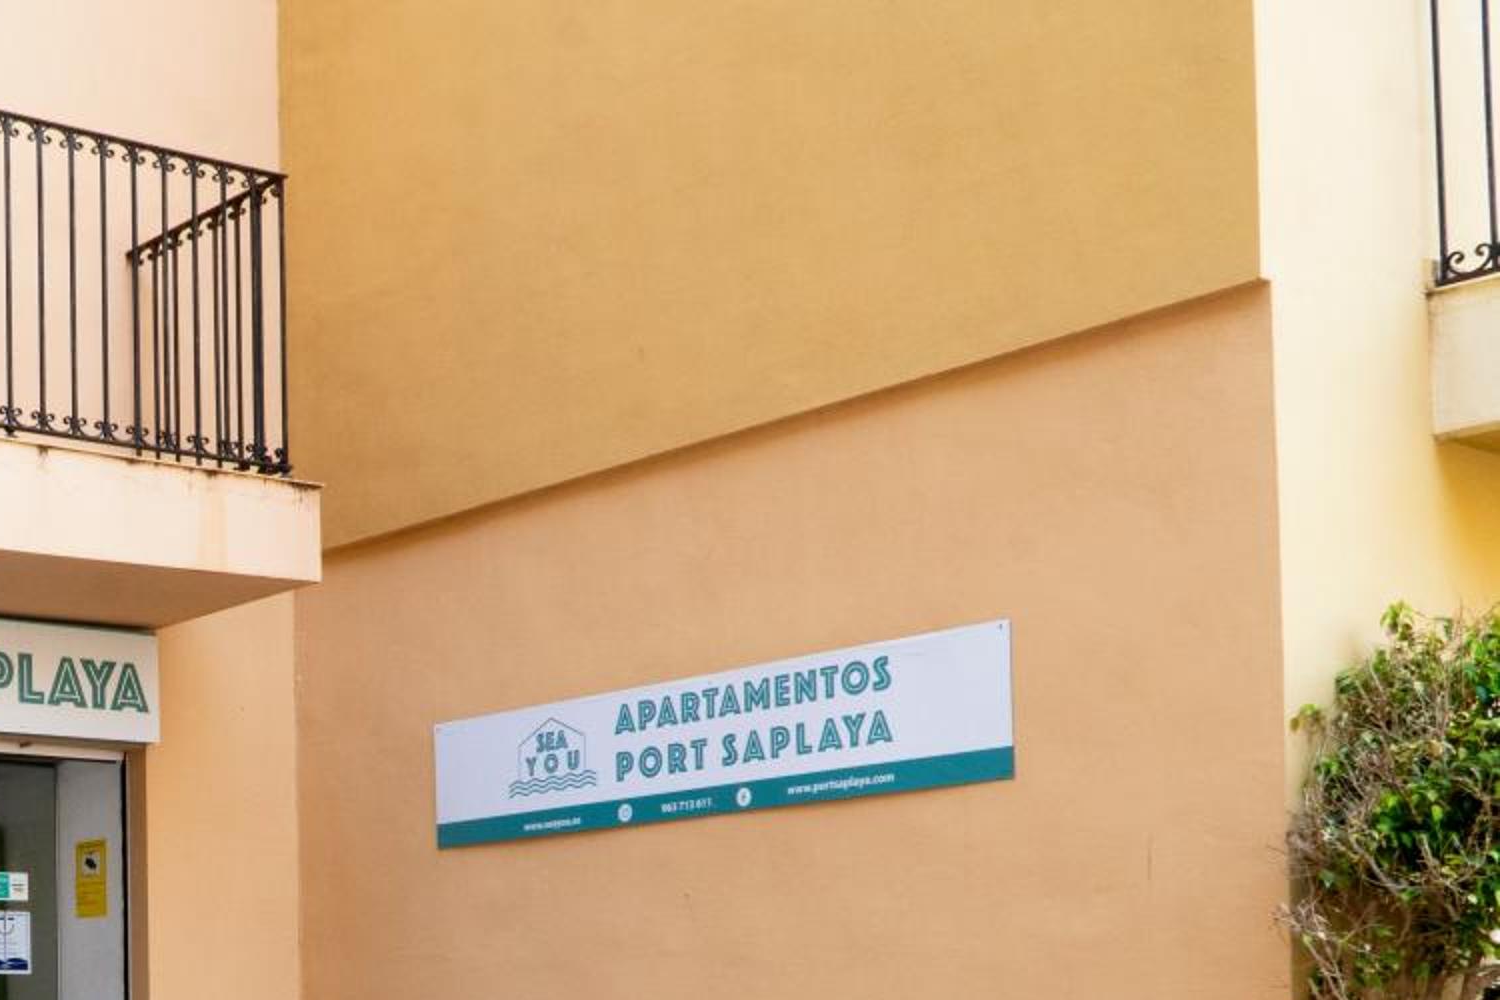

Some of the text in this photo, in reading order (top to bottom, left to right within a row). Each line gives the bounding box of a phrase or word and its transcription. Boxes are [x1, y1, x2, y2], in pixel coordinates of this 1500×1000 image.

[614, 655, 892, 735] APARTAMENTOS
[525, 749, 580, 777] YOU
[536, 729, 569, 753] SEA
[615, 709, 894, 782] PORT SAPLAYA
